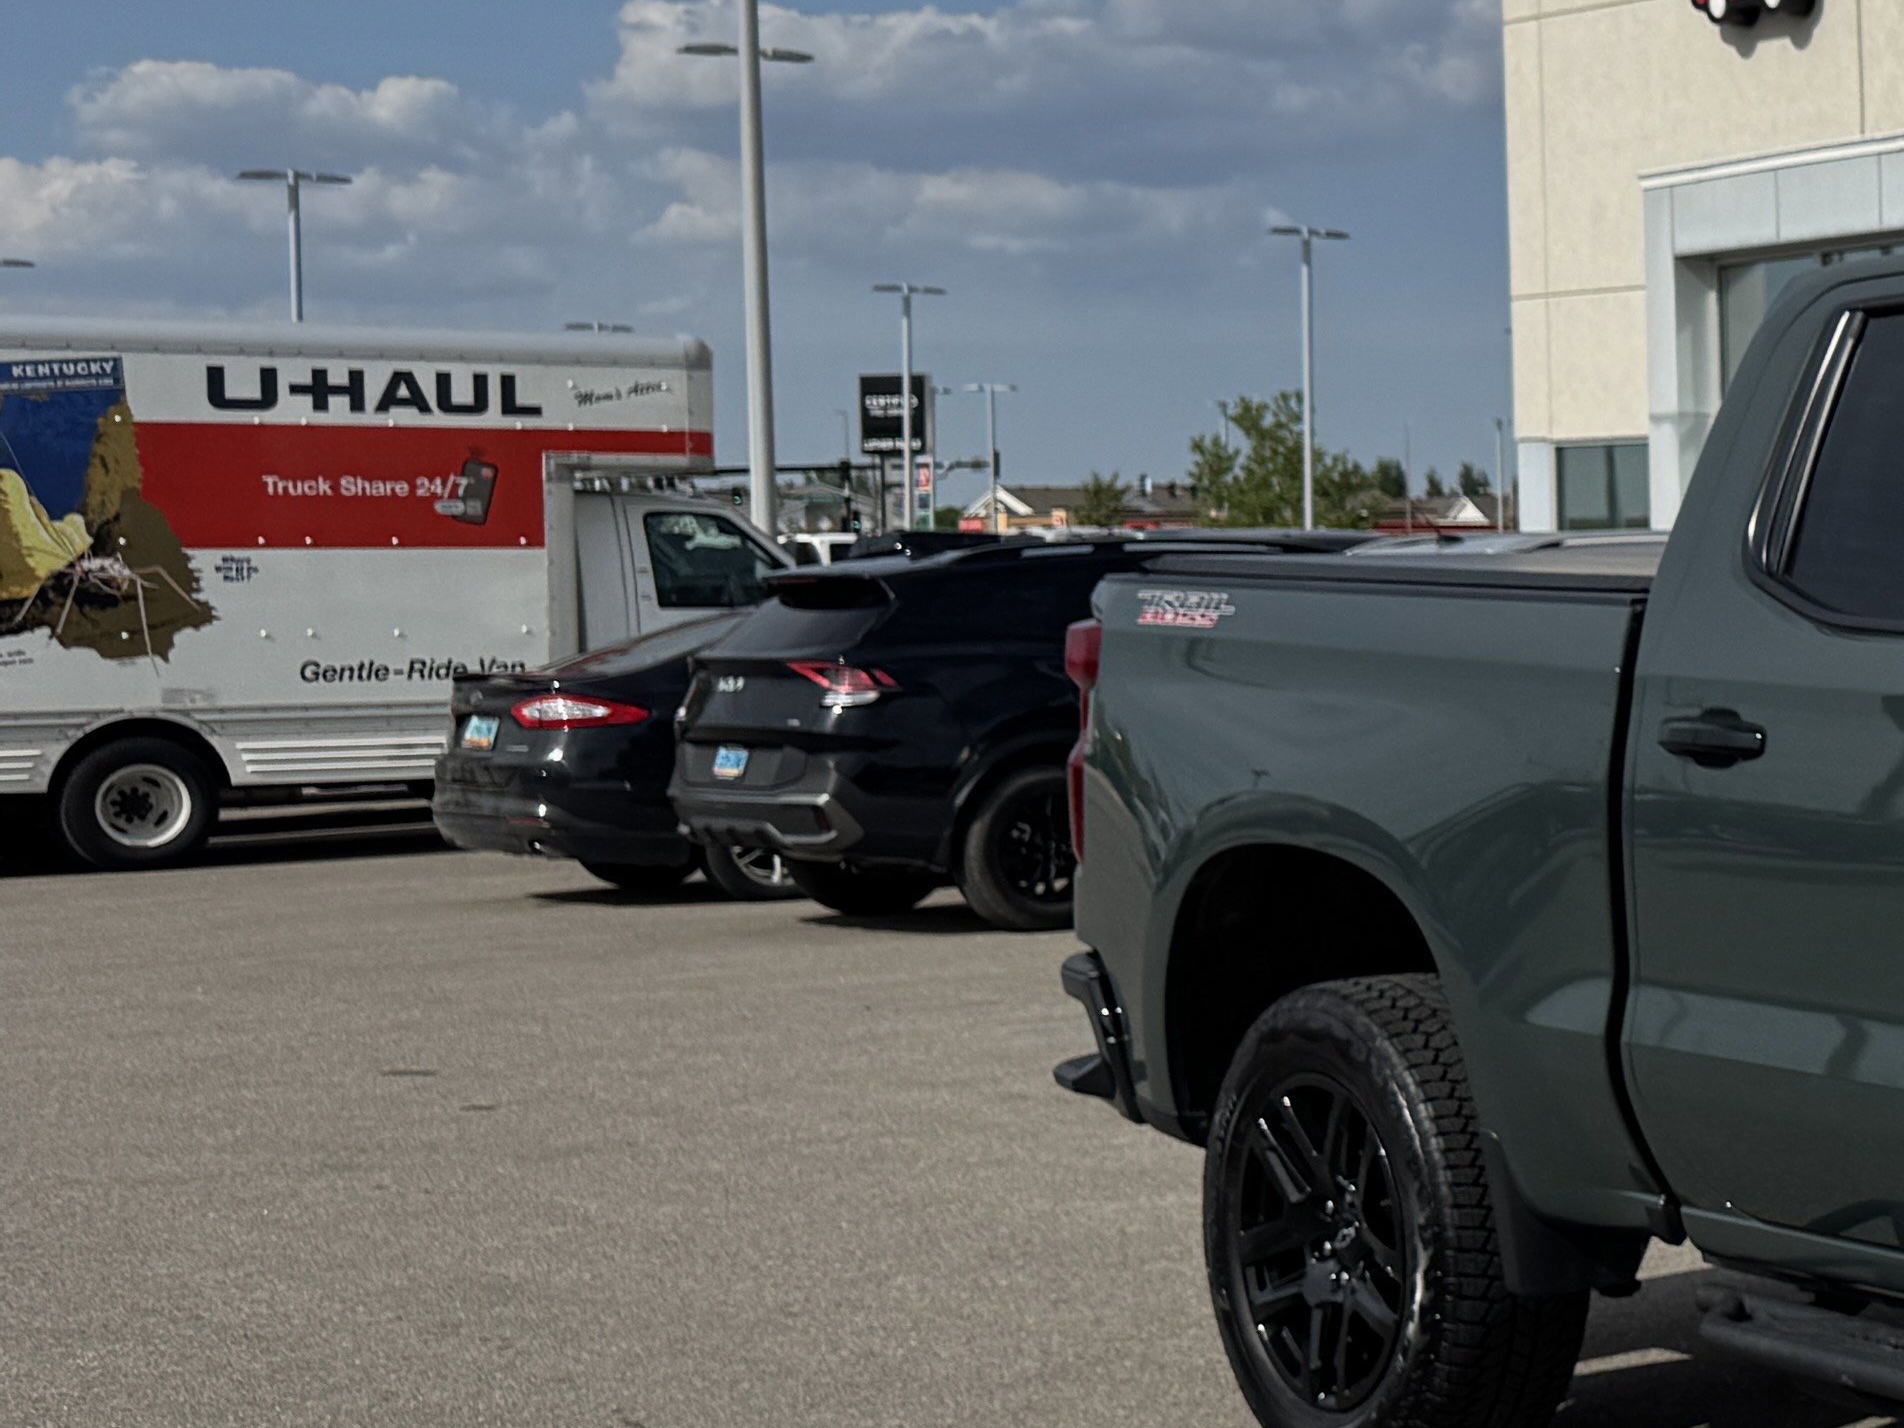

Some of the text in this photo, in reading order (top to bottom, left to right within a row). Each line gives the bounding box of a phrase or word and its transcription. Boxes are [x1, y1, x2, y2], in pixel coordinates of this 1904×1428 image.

[11, 360, 114, 378] KENTUCKY
[205, 365, 543, 417] U-HAUL
[262, 473, 469, 499] Truck Share 24/7
[1138, 590, 1235, 615] TRAIL
[300, 656, 526, 684] Gentle-Ride Van
